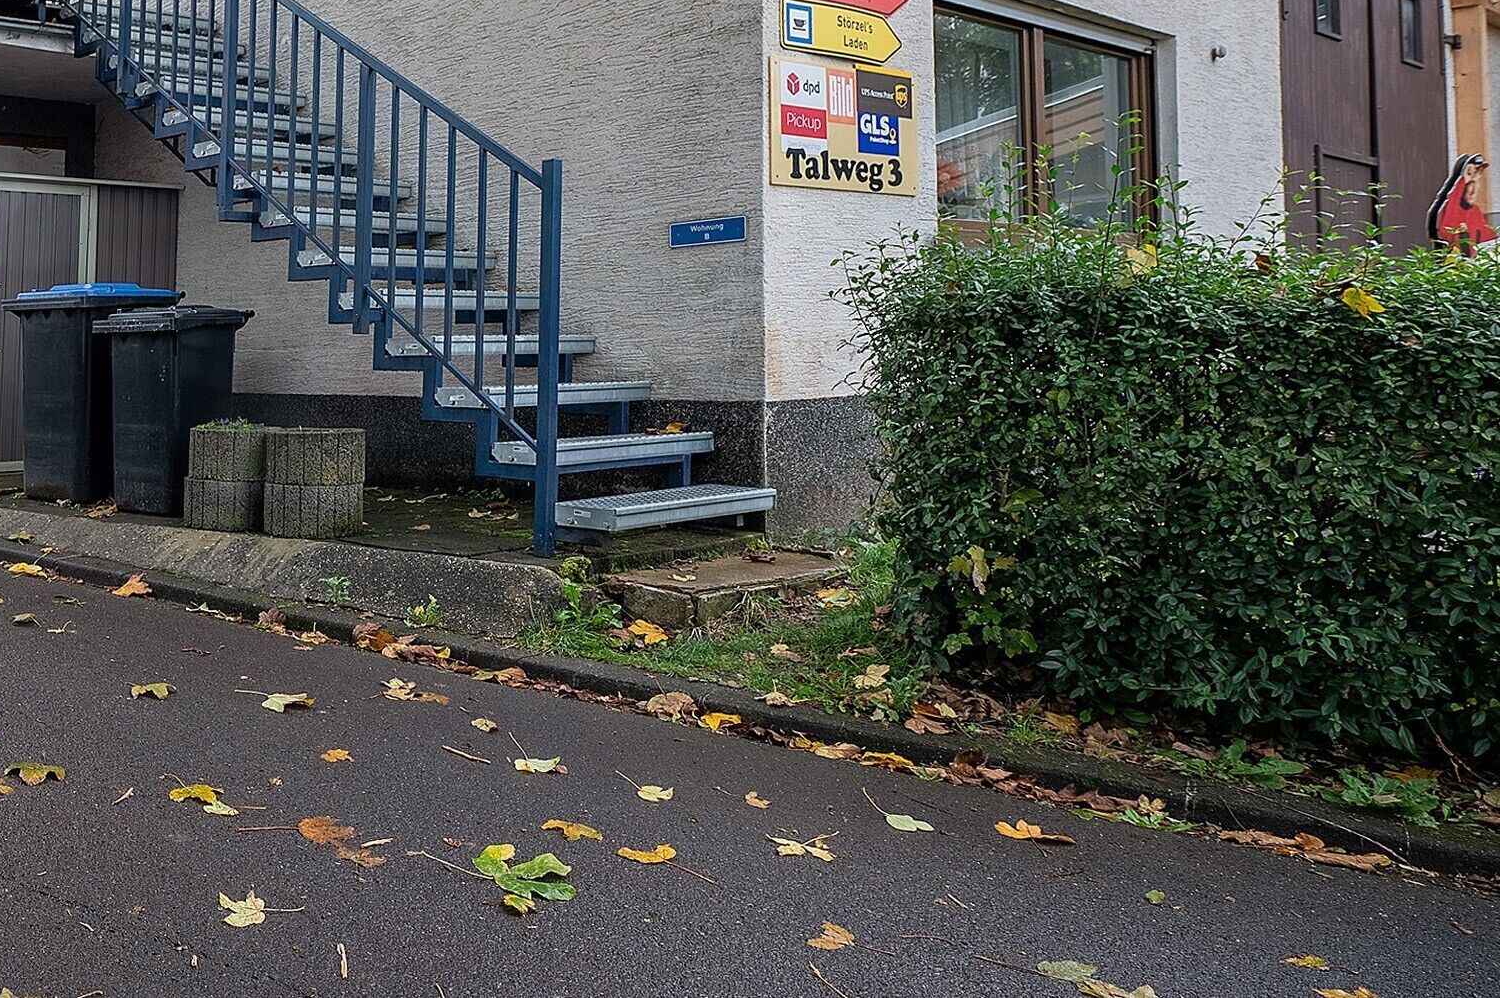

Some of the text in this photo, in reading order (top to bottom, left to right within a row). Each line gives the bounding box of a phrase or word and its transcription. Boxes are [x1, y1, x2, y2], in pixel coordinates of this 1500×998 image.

[837, 15, 873, 34] Störzel's
[843, 35, 868, 51] Laden
[802, 79, 820, 96] dpd
[829, 75, 854, 118] Bild
[786, 111, 822, 133] Pickup
[860, 113, 889, 136] GLS
[786, 147, 903, 192] Talweg 3
[690, 223, 724, 232] Wohnung
